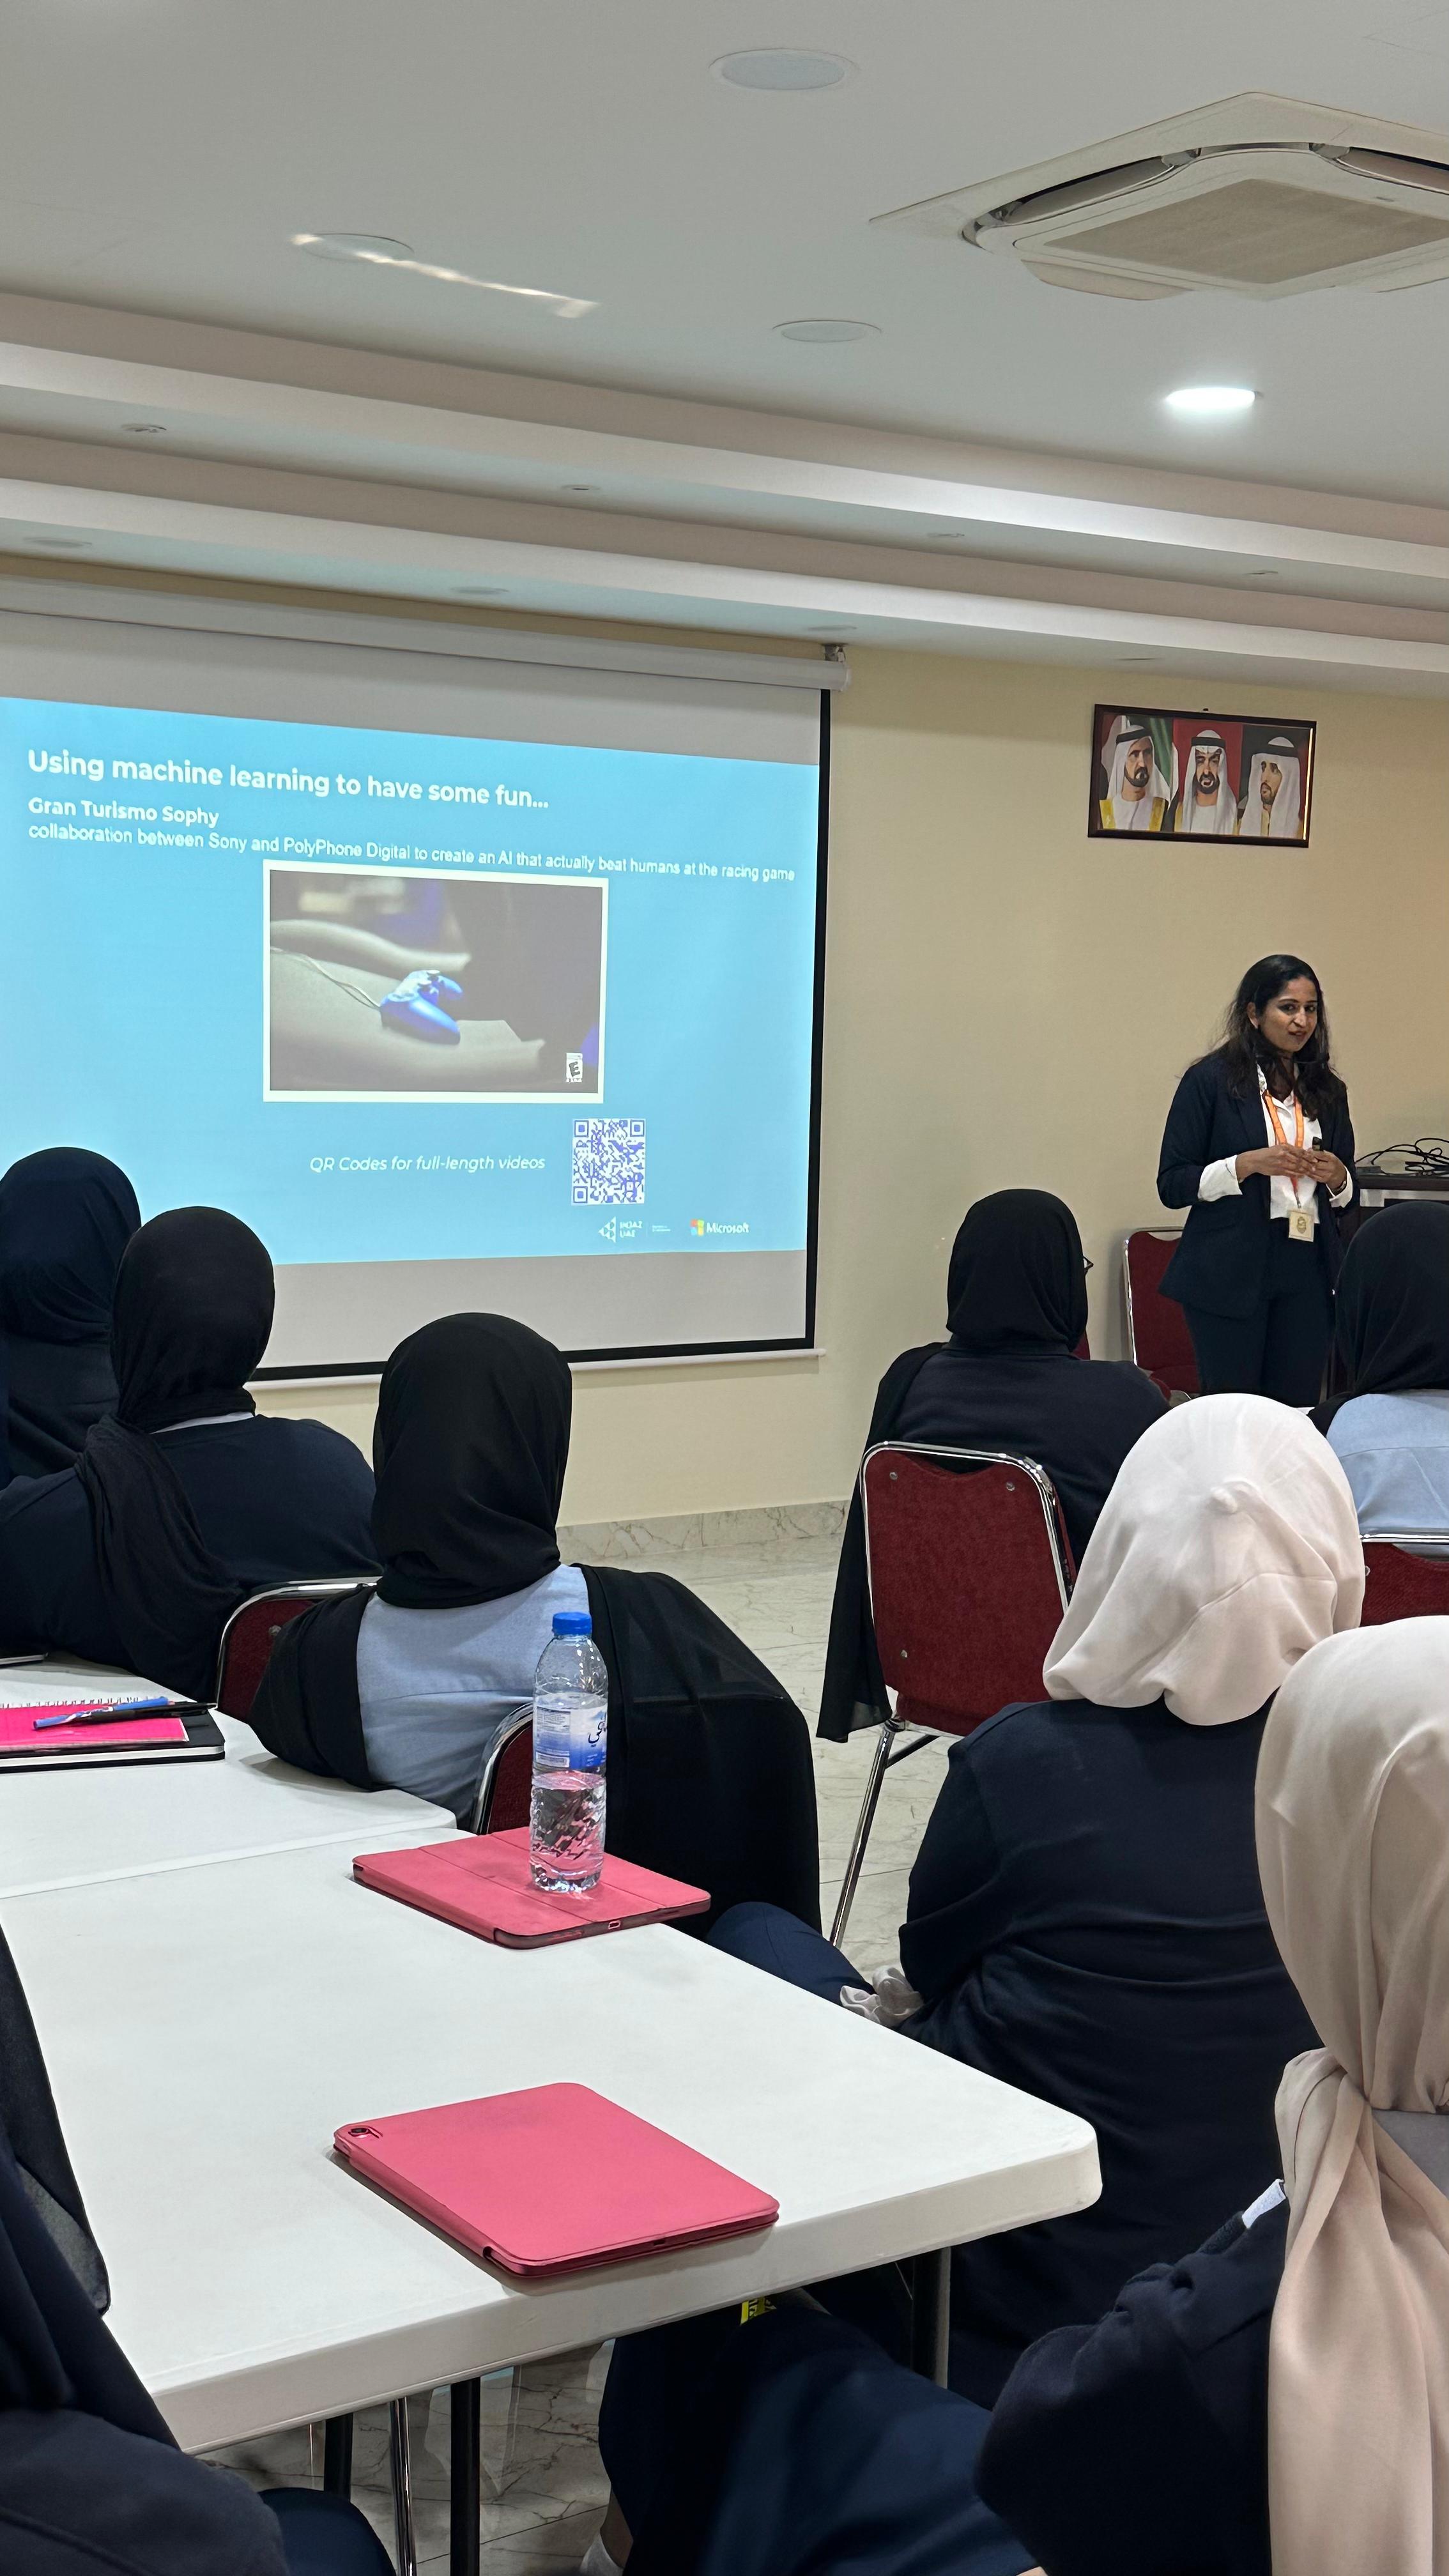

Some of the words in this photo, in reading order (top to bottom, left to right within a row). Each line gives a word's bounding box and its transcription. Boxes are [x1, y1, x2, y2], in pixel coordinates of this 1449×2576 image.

[28, 749, 104, 782] Using
[112, 759, 223, 786] machine
[230, 764, 330, 797] learning
[335, 774, 362, 795] to
[367, 775, 423, 800] have
[428, 785, 490, 804] some
[494, 784, 549, 808] fun...
[27, 797, 77, 816] Gran
[80, 800, 158, 821] Turismo
[162, 806, 219, 829] Sophy
[28, 822, 132, 844] collaboration
[138, 828, 203, 847] between
[208, 832, 247, 854] Sony
[250, 837, 280, 852] and
[284, 837, 362, 857] PolyPhone
[366, 842, 410, 862] Digital
[414, 847, 428, 861] to
[431, 849, 475, 863] create
[478, 852, 496, 864] an
[498, 850, 512, 865] AI
[516, 852, 542, 867] that
[545, 855, 595, 873] actually
[598, 856, 627, 872] beat
[630, 857, 680, 875] humans
[683, 862, 696, 875] at
[698, 862, 718, 877] the
[721, 866, 759, 882] racing
[762, 868, 795, 883] game
[569, 1061, 581, 1077] E
[309, 1157, 335, 1174] QR
[339, 1156, 387, 1171] Codes
[391, 1155, 413, 1170] for
[416, 1155, 494, 1174] full-length
[498, 1155, 546, 1169] videos
[706, 1222, 749, 1234] Microsoft
